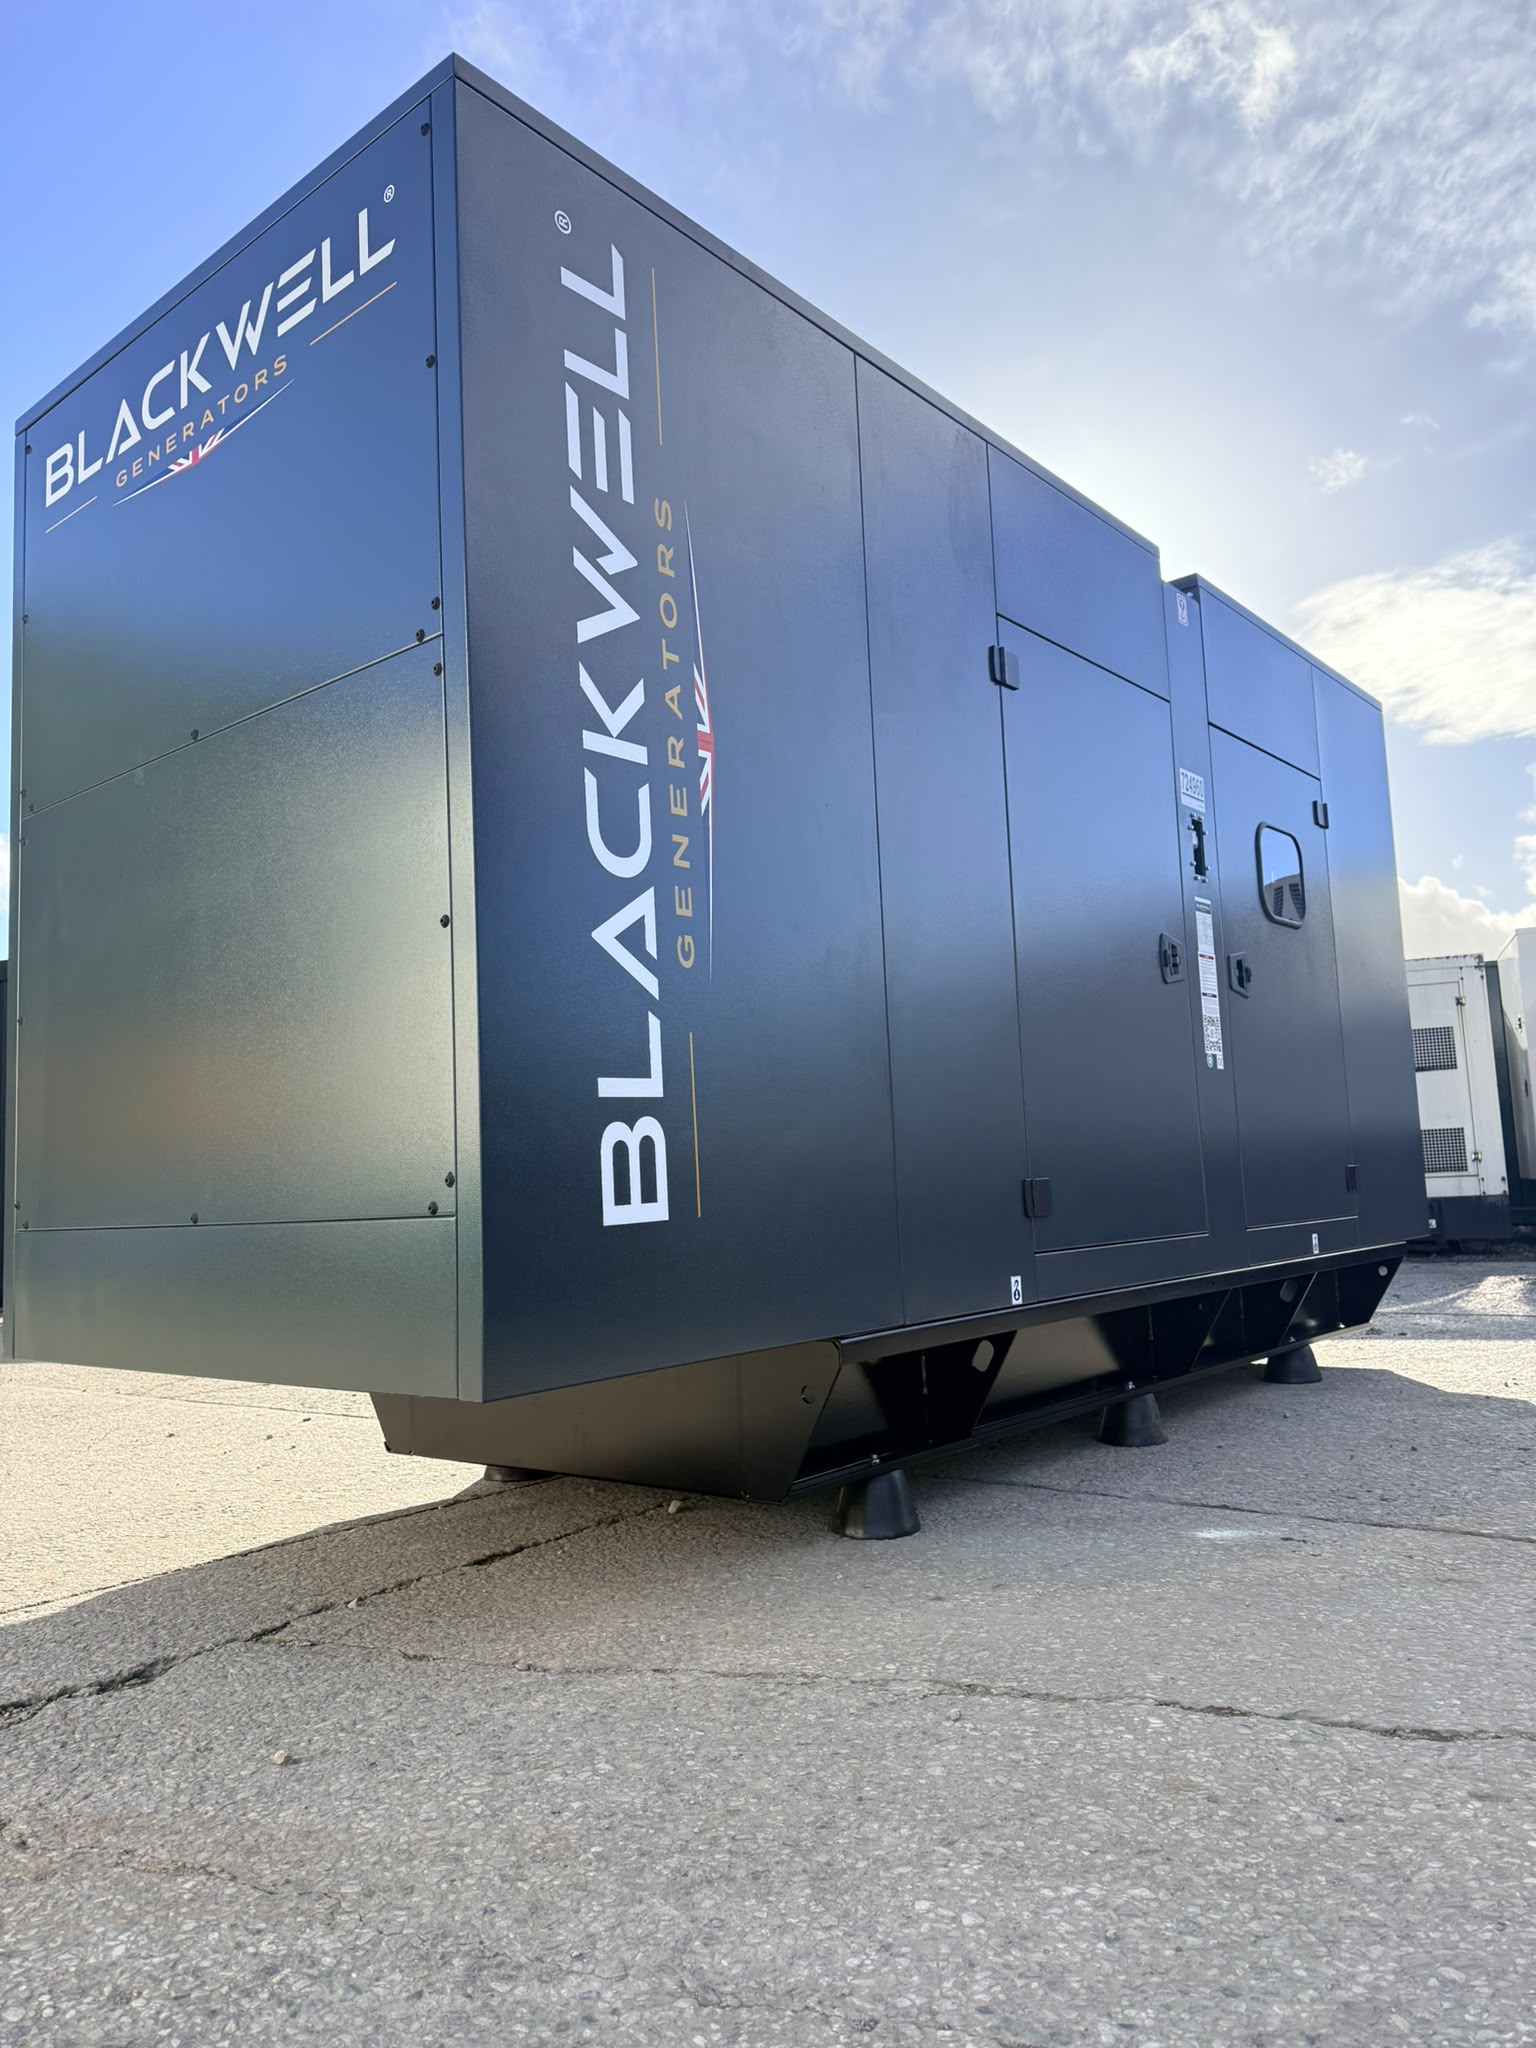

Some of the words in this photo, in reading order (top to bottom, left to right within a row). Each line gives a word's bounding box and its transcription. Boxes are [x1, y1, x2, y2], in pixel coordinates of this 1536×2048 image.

[45, 207, 396, 508] BLACKWELL
[115, 354, 288, 488] GENERATORS
[560, 243, 669, 1226] BLACKWELL
[654, 497, 695, 969] GENERATORS
